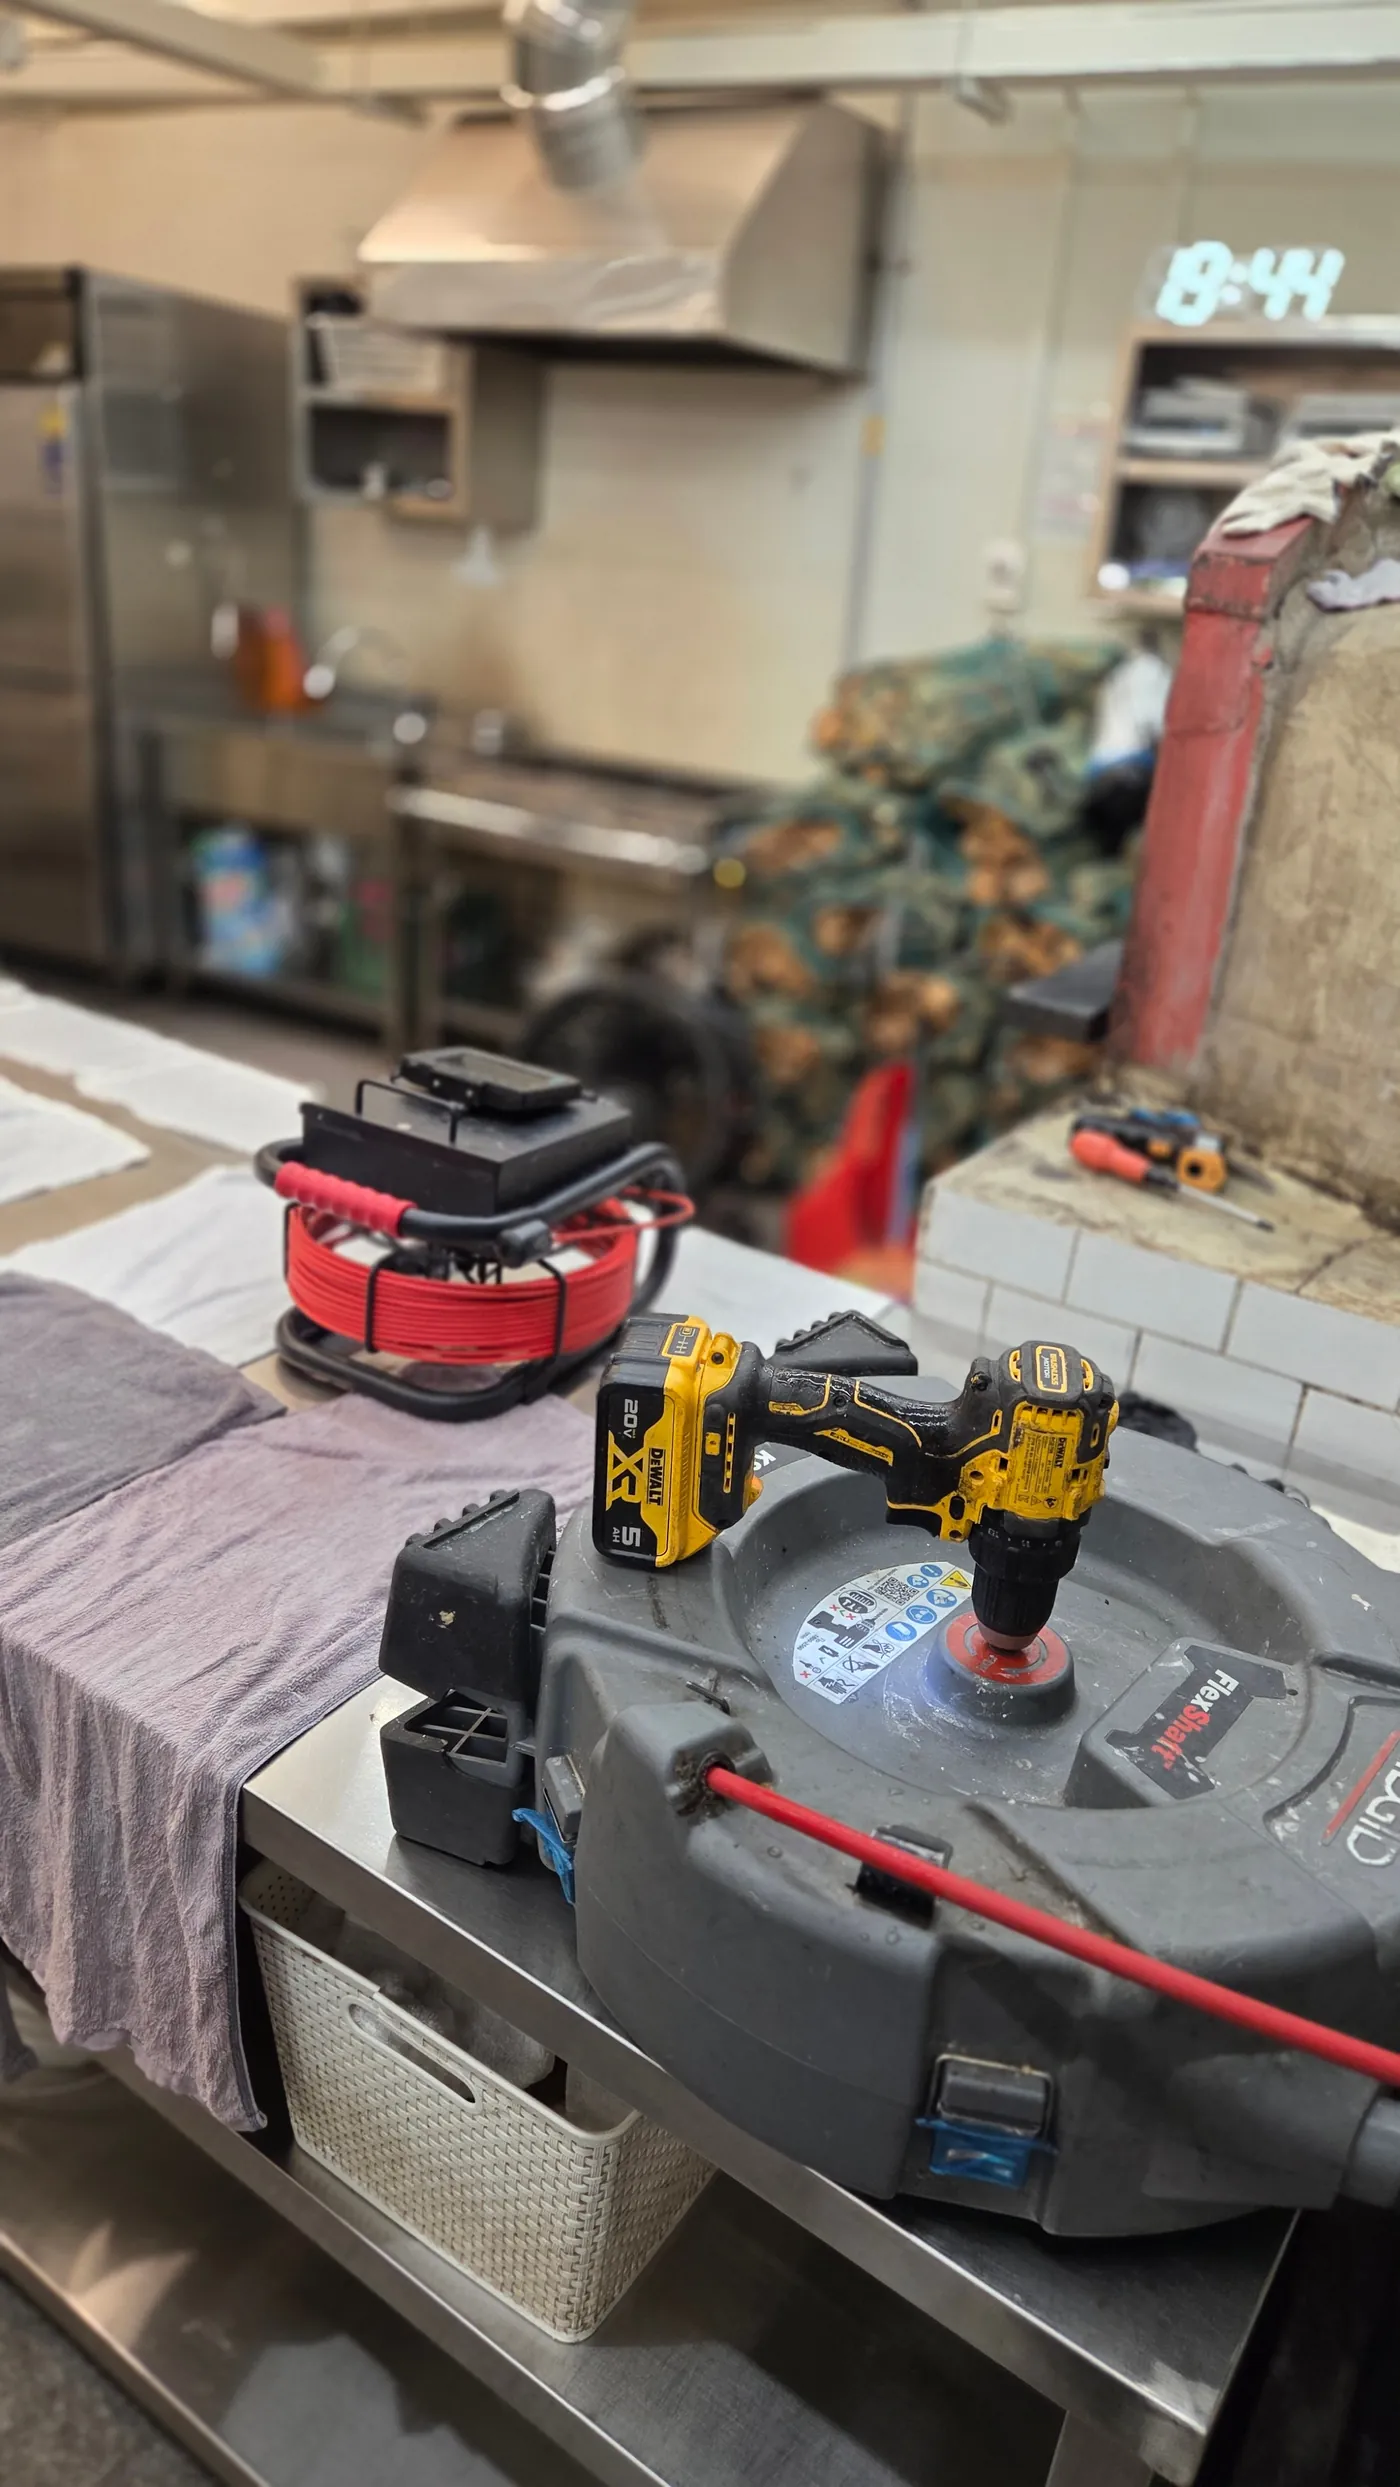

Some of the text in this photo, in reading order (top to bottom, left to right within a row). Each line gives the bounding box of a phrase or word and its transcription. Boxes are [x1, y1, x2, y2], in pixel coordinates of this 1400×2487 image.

[606, 1430, 646, 1510] XR
[650, 1448, 663, 1505] DEWALT
[612, 1527, 620, 1543] AH
[621, 1526, 640, 1547] 5
[1151, 1669, 1239, 1765] FlexShaft
